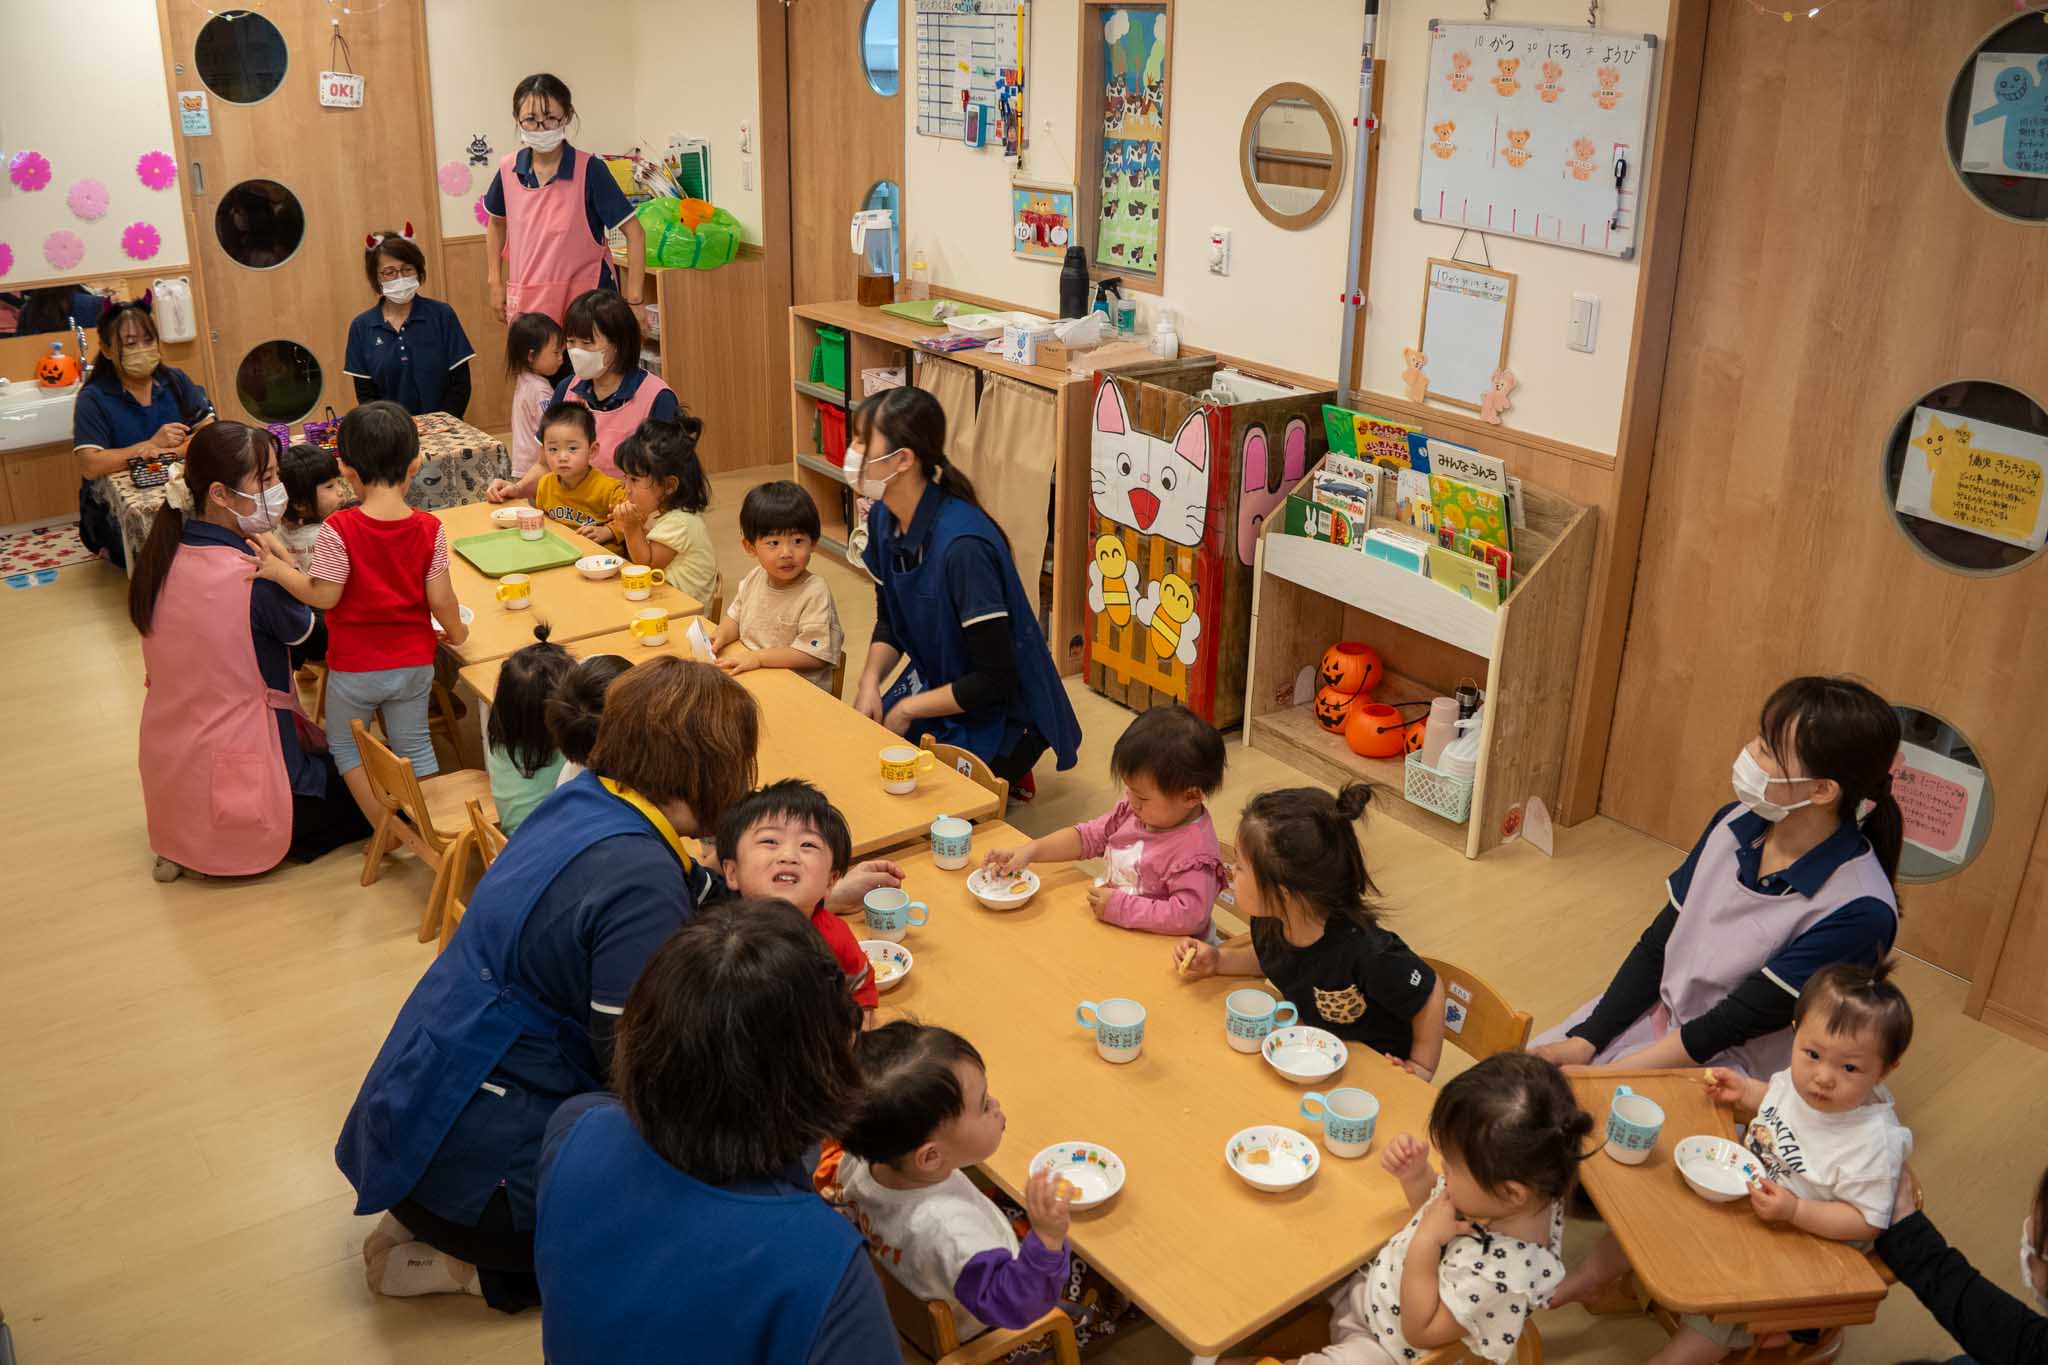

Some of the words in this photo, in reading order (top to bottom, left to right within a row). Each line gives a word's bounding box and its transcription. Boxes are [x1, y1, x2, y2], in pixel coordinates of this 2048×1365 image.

[1474, 35, 1485, 48] 10
[1489, 34, 1515, 53] がつ
[1548, 42, 1572, 58] にち
[1602, 45, 1641, 65] ようび
[330, 83, 354, 98] OK!
[1018, 226, 1028, 239] 10
[1437, 453, 1498, 481] みんなうんち
[1467, 491, 1498, 511] しぜん
